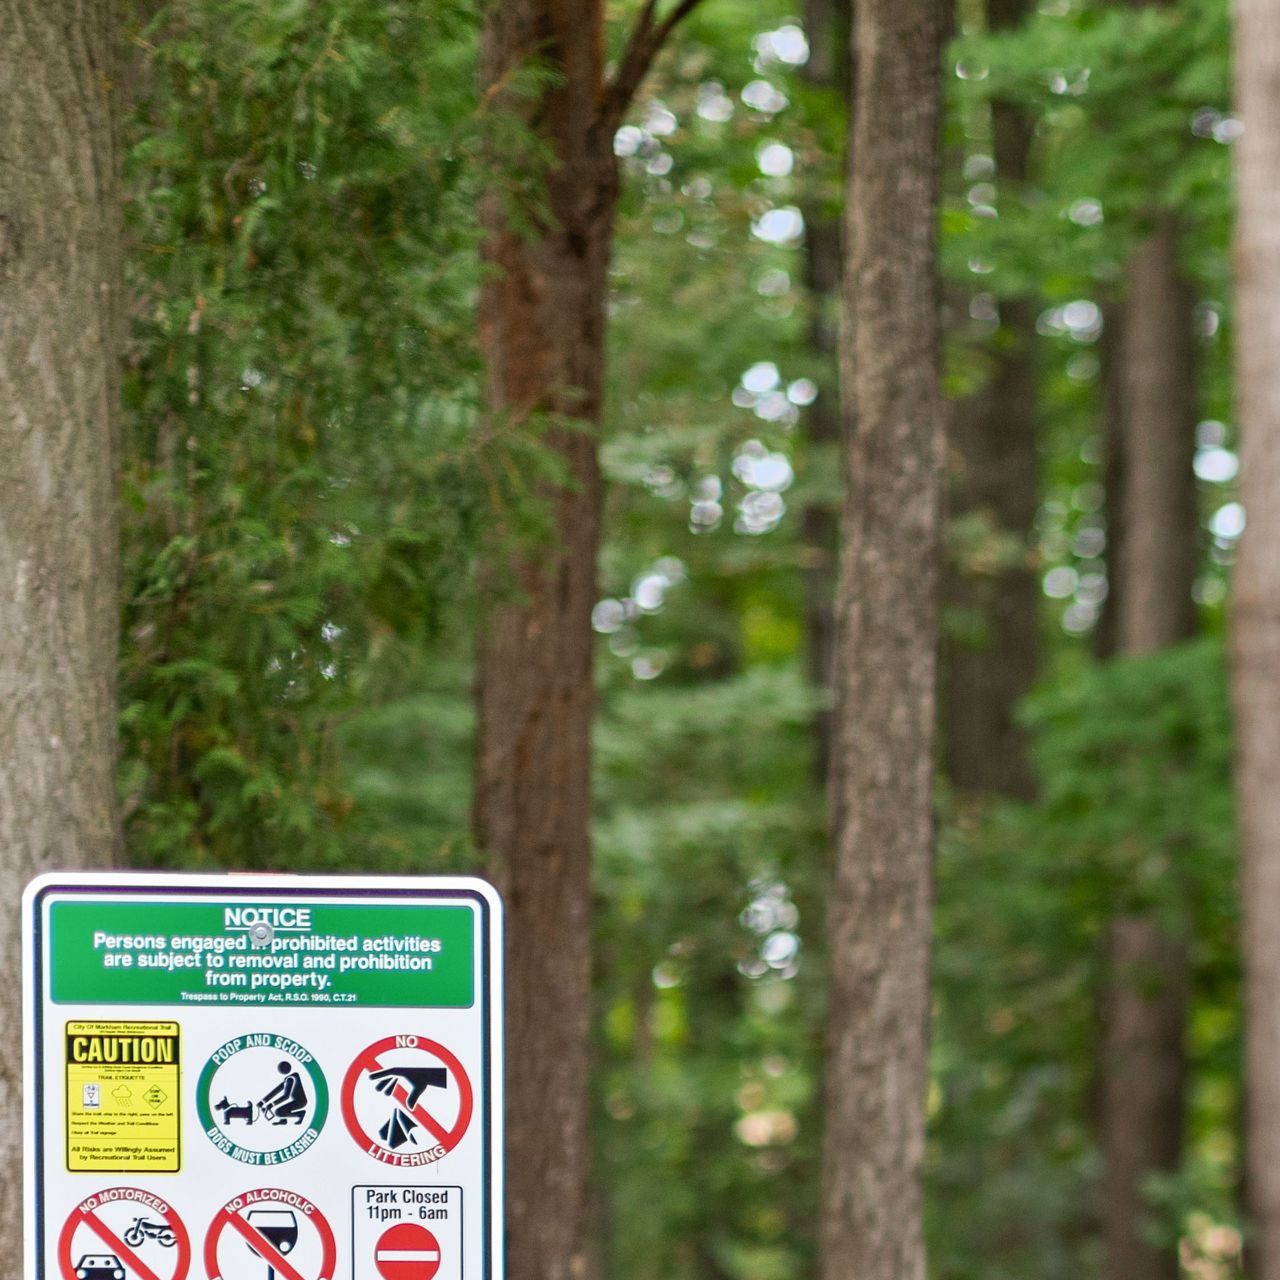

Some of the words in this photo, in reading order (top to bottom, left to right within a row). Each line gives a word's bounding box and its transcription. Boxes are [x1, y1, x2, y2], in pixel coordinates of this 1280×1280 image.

[224, 908, 311, 927] NOTICE
[93, 932, 166, 949] Persons
[171, 935, 246, 953] engaged
[270, 936, 358, 953] prohibited
[362, 936, 442, 952] activities
[104, 954, 133, 967] are
[138, 952, 202, 971] subject
[206, 953, 224, 968] to
[228, 953, 298, 969] removal
[303, 954, 335, 969] and
[340, 954, 432, 973] prohibition
[205, 971, 246, 986] from
[251, 973, 332, 990] property.
[73, 1037, 173, 1063] CAUTION
[212, 1038, 242, 1066] POOP
[246, 1034, 271, 1048] AND
[274, 1036, 313, 1064] SCOOP
[395, 1035, 418, 1048] NO
[207, 1127, 233, 1154] DOGS
[231, 1148, 262, 1165] MUST
[264, 1152, 278, 1165] BE
[278, 1128, 318, 1163] LEASHED
[367, 1143, 446, 1166] LITTERING
[79, 1197, 98, 1215] NO
[98, 1189, 168, 1215] MOTORIZED
[224, 1198, 243, 1215] NO
[245, 1189, 315, 1215] ALCOHOLIC
[366, 1190, 397, 1203] Park
[403, 1190, 448, 1203] Closed
[367, 1205, 401, 1222] 11pm
[418, 1206, 448, 1220] 6am
